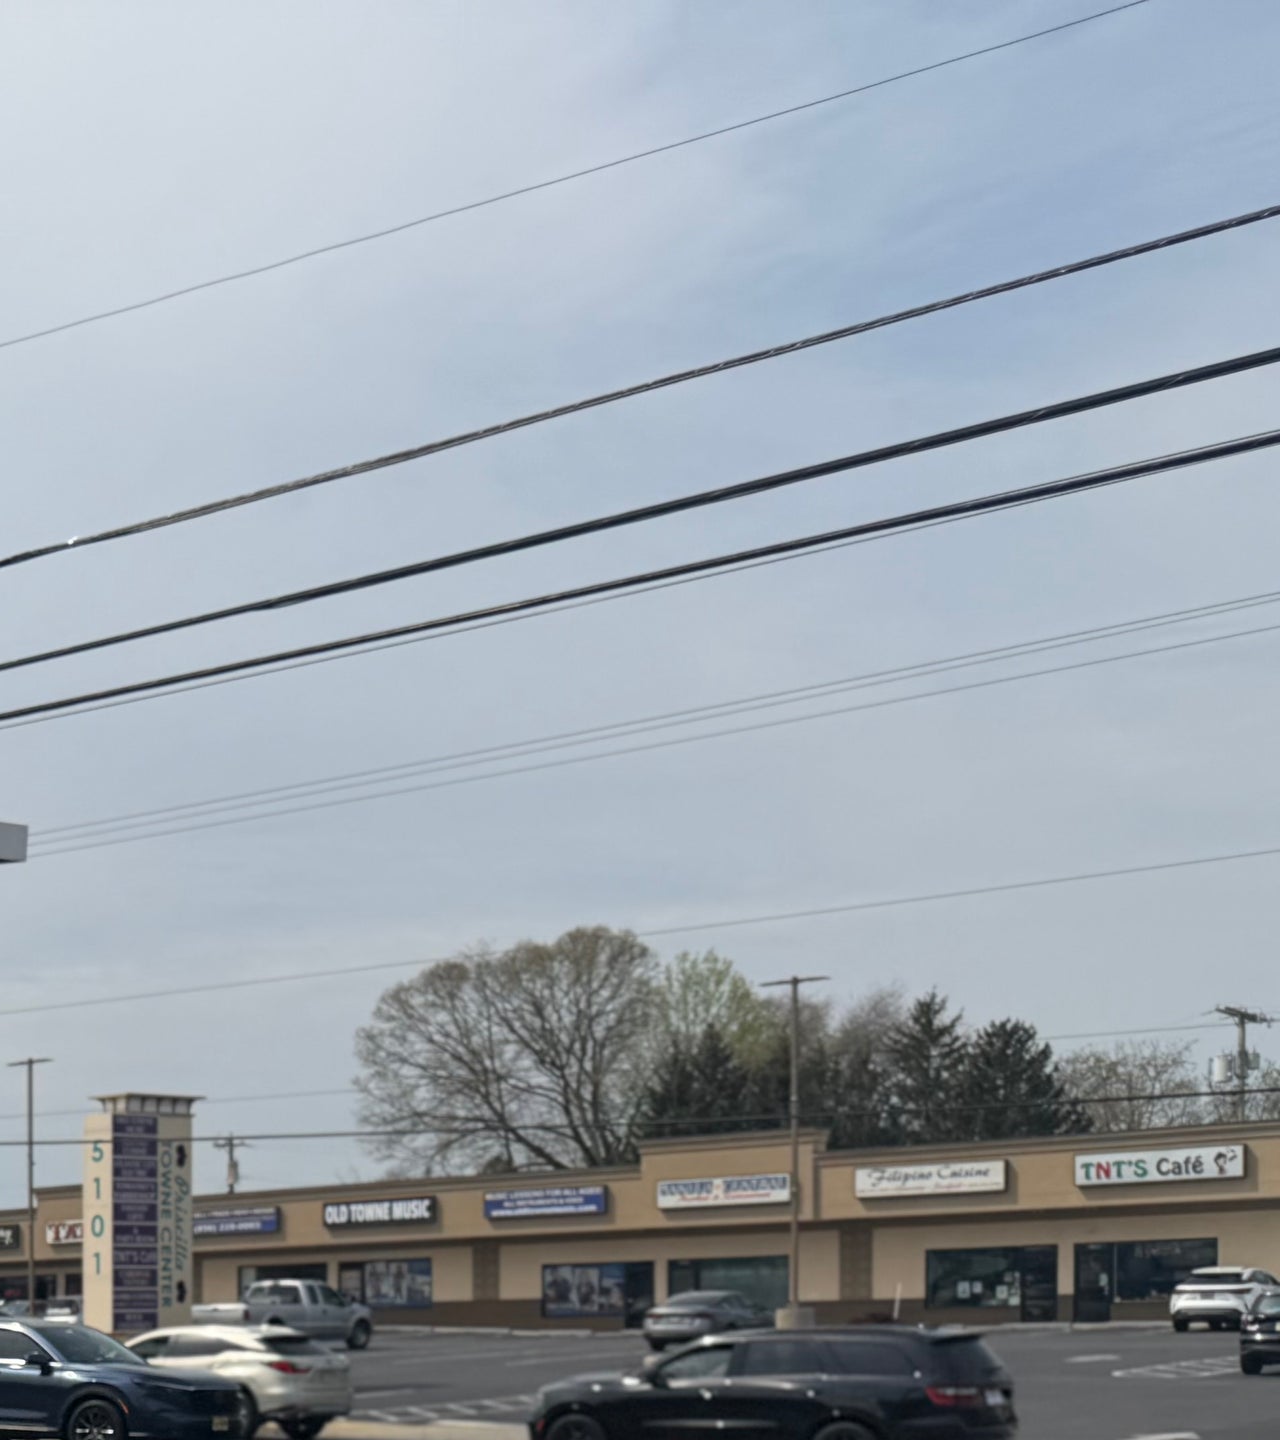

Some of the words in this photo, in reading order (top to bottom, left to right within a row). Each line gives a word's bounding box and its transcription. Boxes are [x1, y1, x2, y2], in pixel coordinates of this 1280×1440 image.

[161, 1141, 173, 1219] TOWNE
[868, 1167, 932, 1187] Filipino
[937, 1164, 990, 1180] Cuisine
[1080, 1159, 1148, 1181] TNT'S
[1156, 1155, 1204, 1176] Café
[325, 1204, 348, 1224] OLD
[349, 1201, 390, 1223] TOWNE
[392, 1199, 431, 1220] MUSIC
[161, 1227, 173, 1307] CENTER
